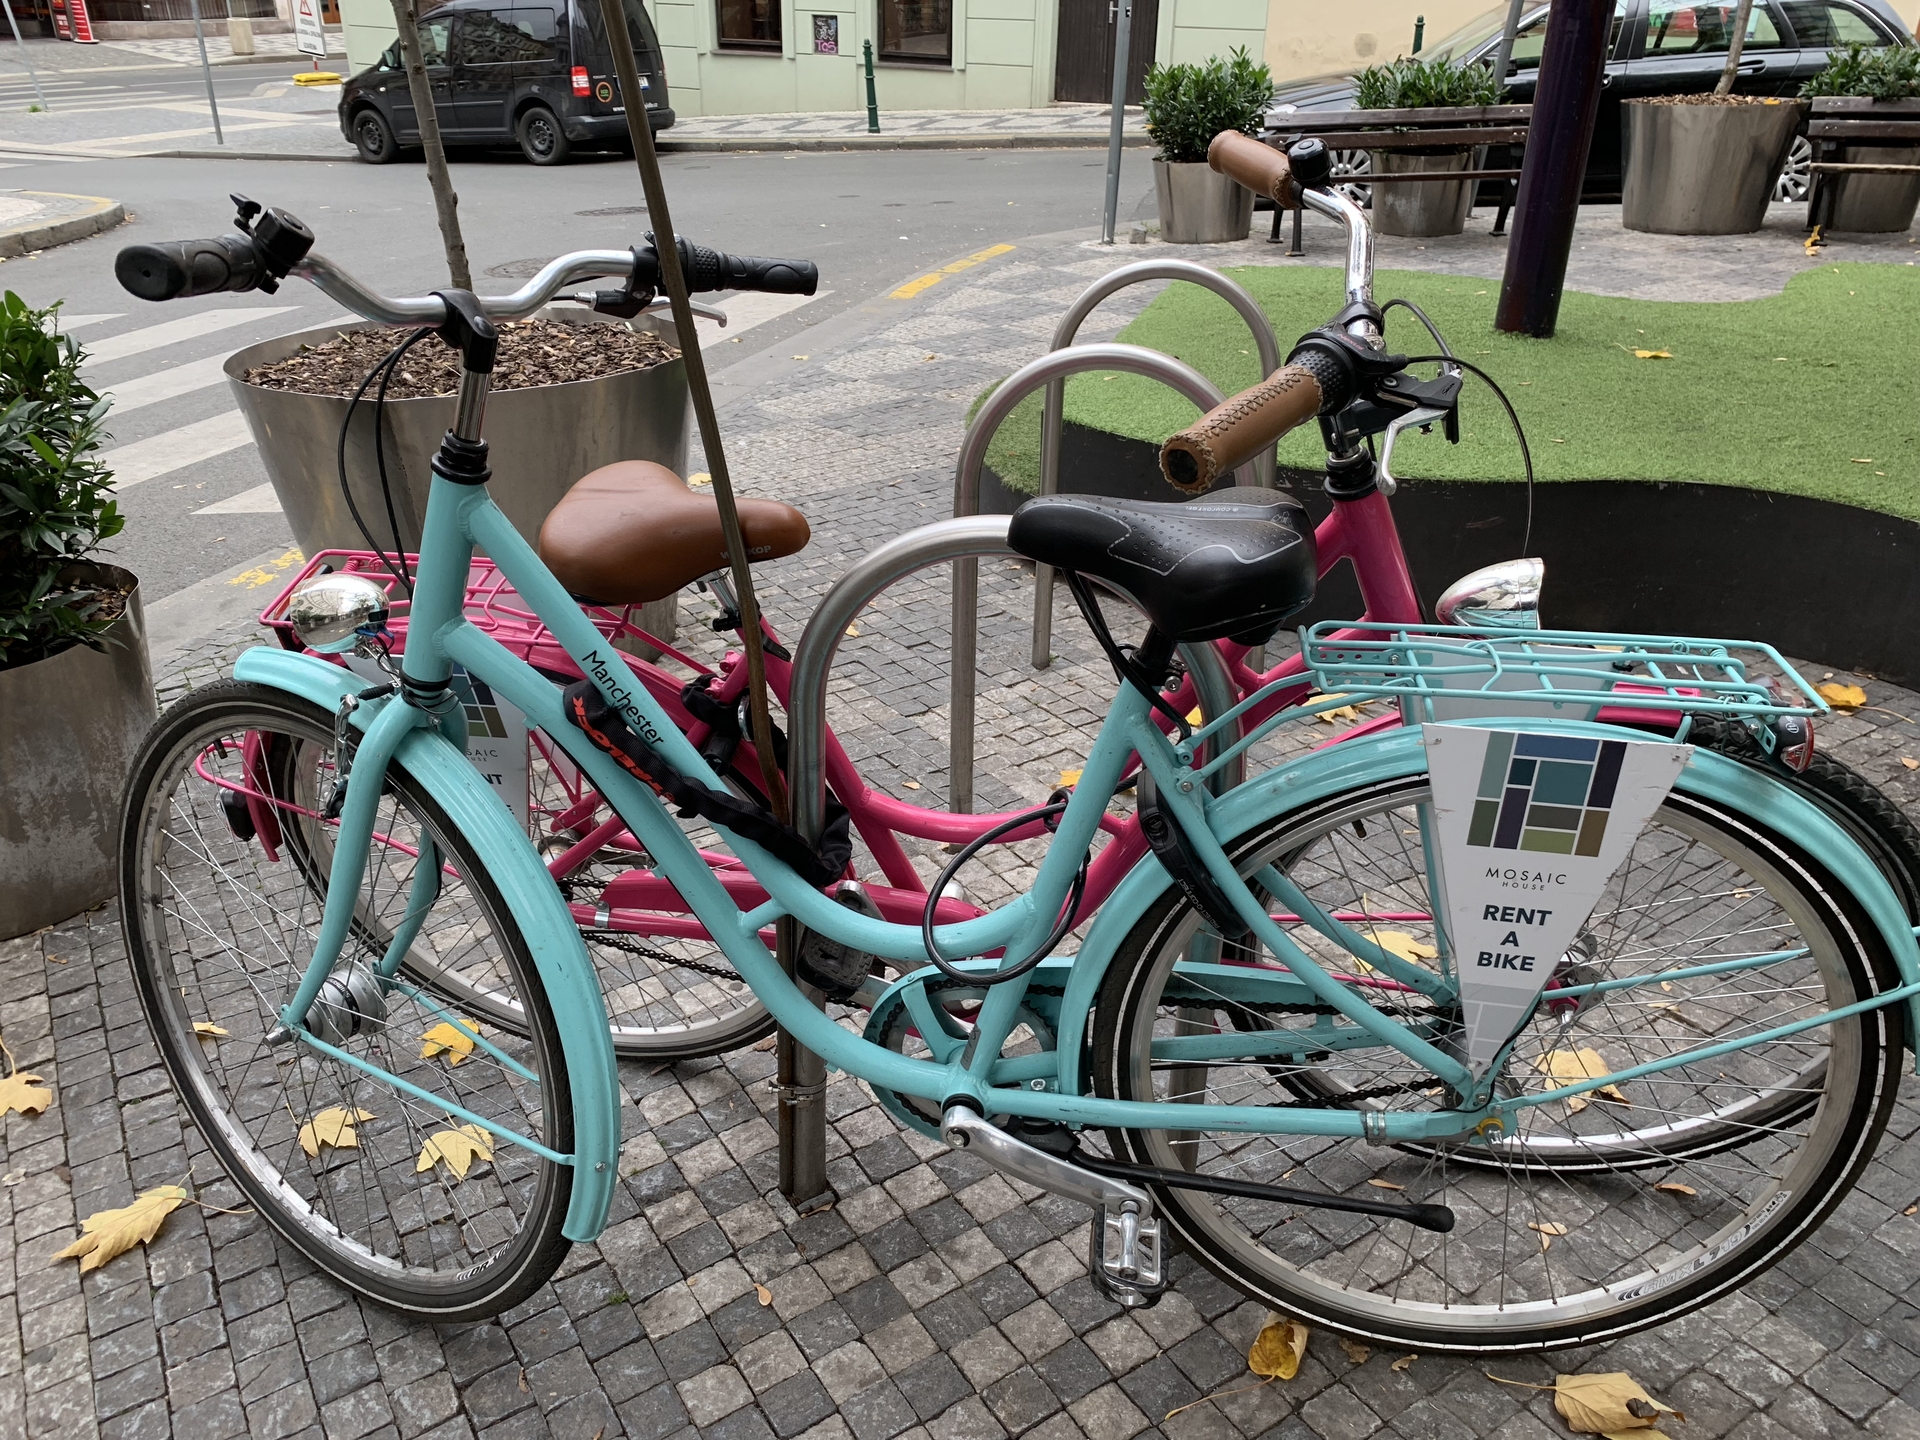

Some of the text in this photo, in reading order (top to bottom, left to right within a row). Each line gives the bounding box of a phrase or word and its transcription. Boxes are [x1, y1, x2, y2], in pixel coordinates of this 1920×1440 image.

[582, 650, 664, 745] Manchester
[466, 748, 498, 758] SAIC
[572, 696, 664, 793] TRELOCK
[1485, 867, 1567, 885] MOSAIC
[1502, 881, 1545, 891] HOUSE
[1482, 904, 1552, 926] RENT
[1499, 930, 1519, 947] A
[1476, 951, 1536, 972] BIKE
